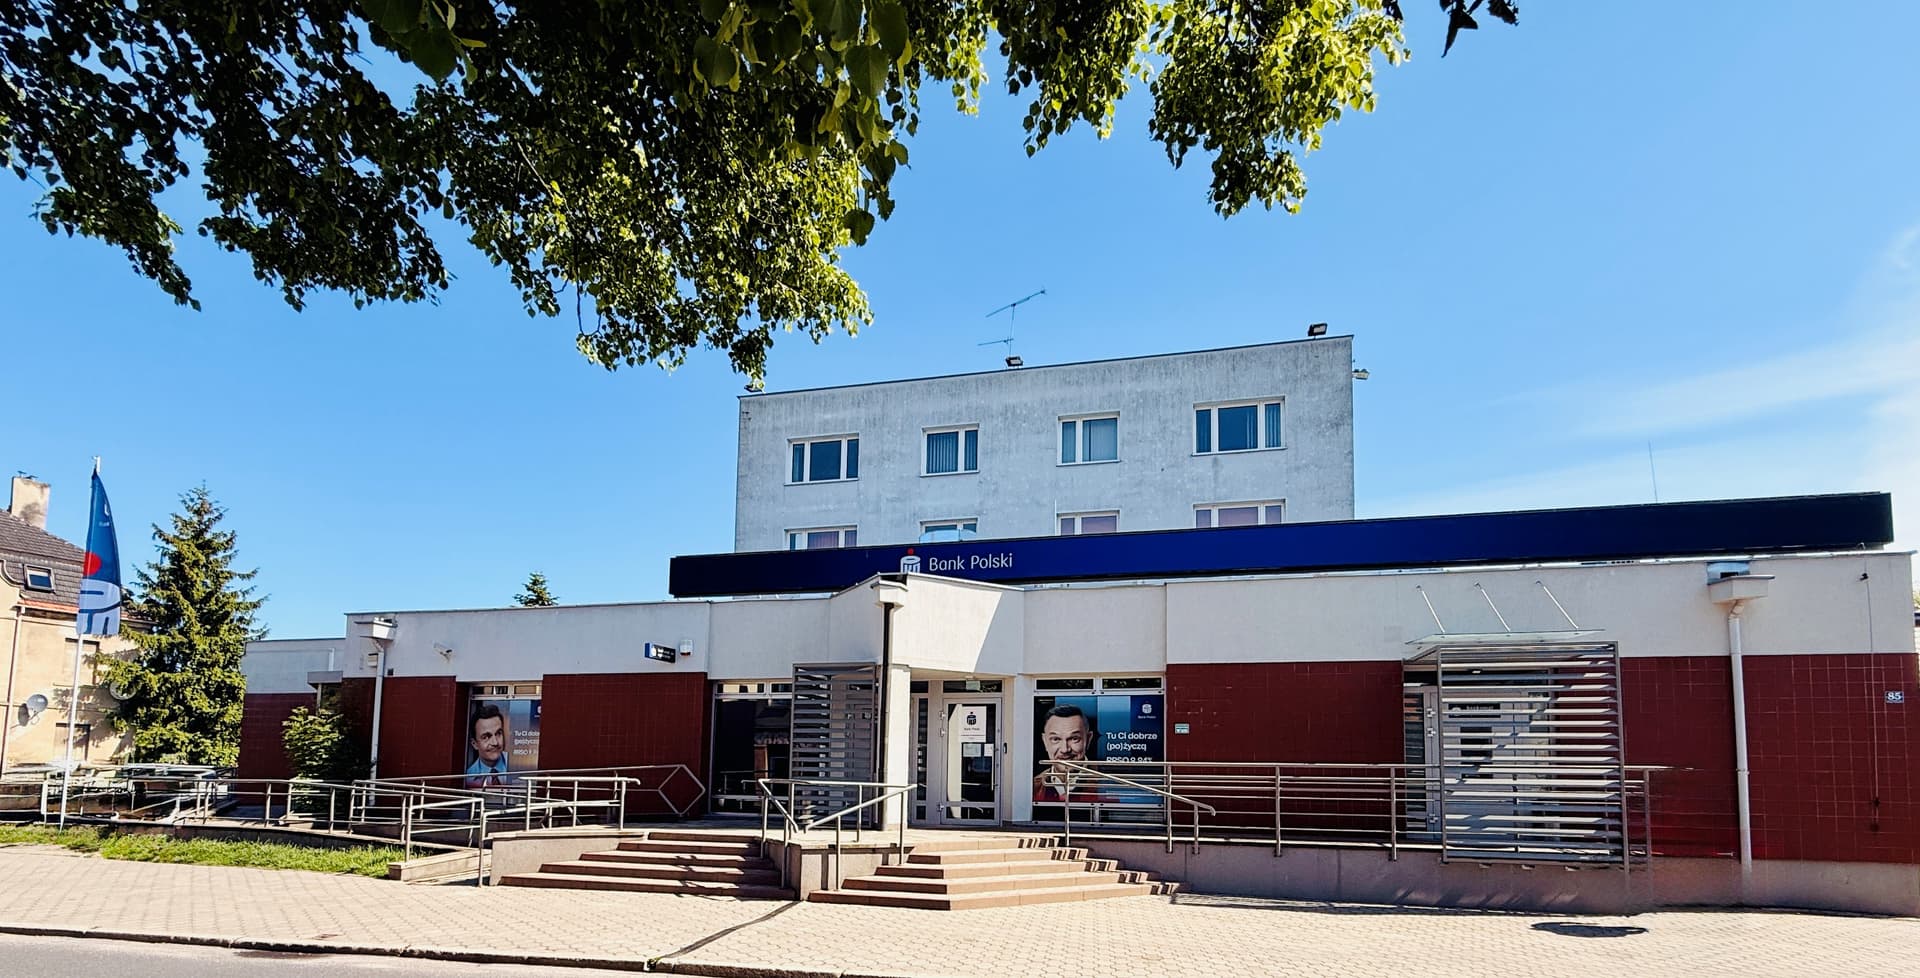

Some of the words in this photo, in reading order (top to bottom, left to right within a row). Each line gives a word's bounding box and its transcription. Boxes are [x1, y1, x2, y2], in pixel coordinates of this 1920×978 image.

[929, 555, 965, 571] Bank
[970, 553, 1013, 569] Polski
[1887, 692, 1902, 700] 85
[1106, 732, 1117, 740] Tu
[1117, 732, 1127, 740] Ci
[1127, 731, 1158, 740] dobrze
